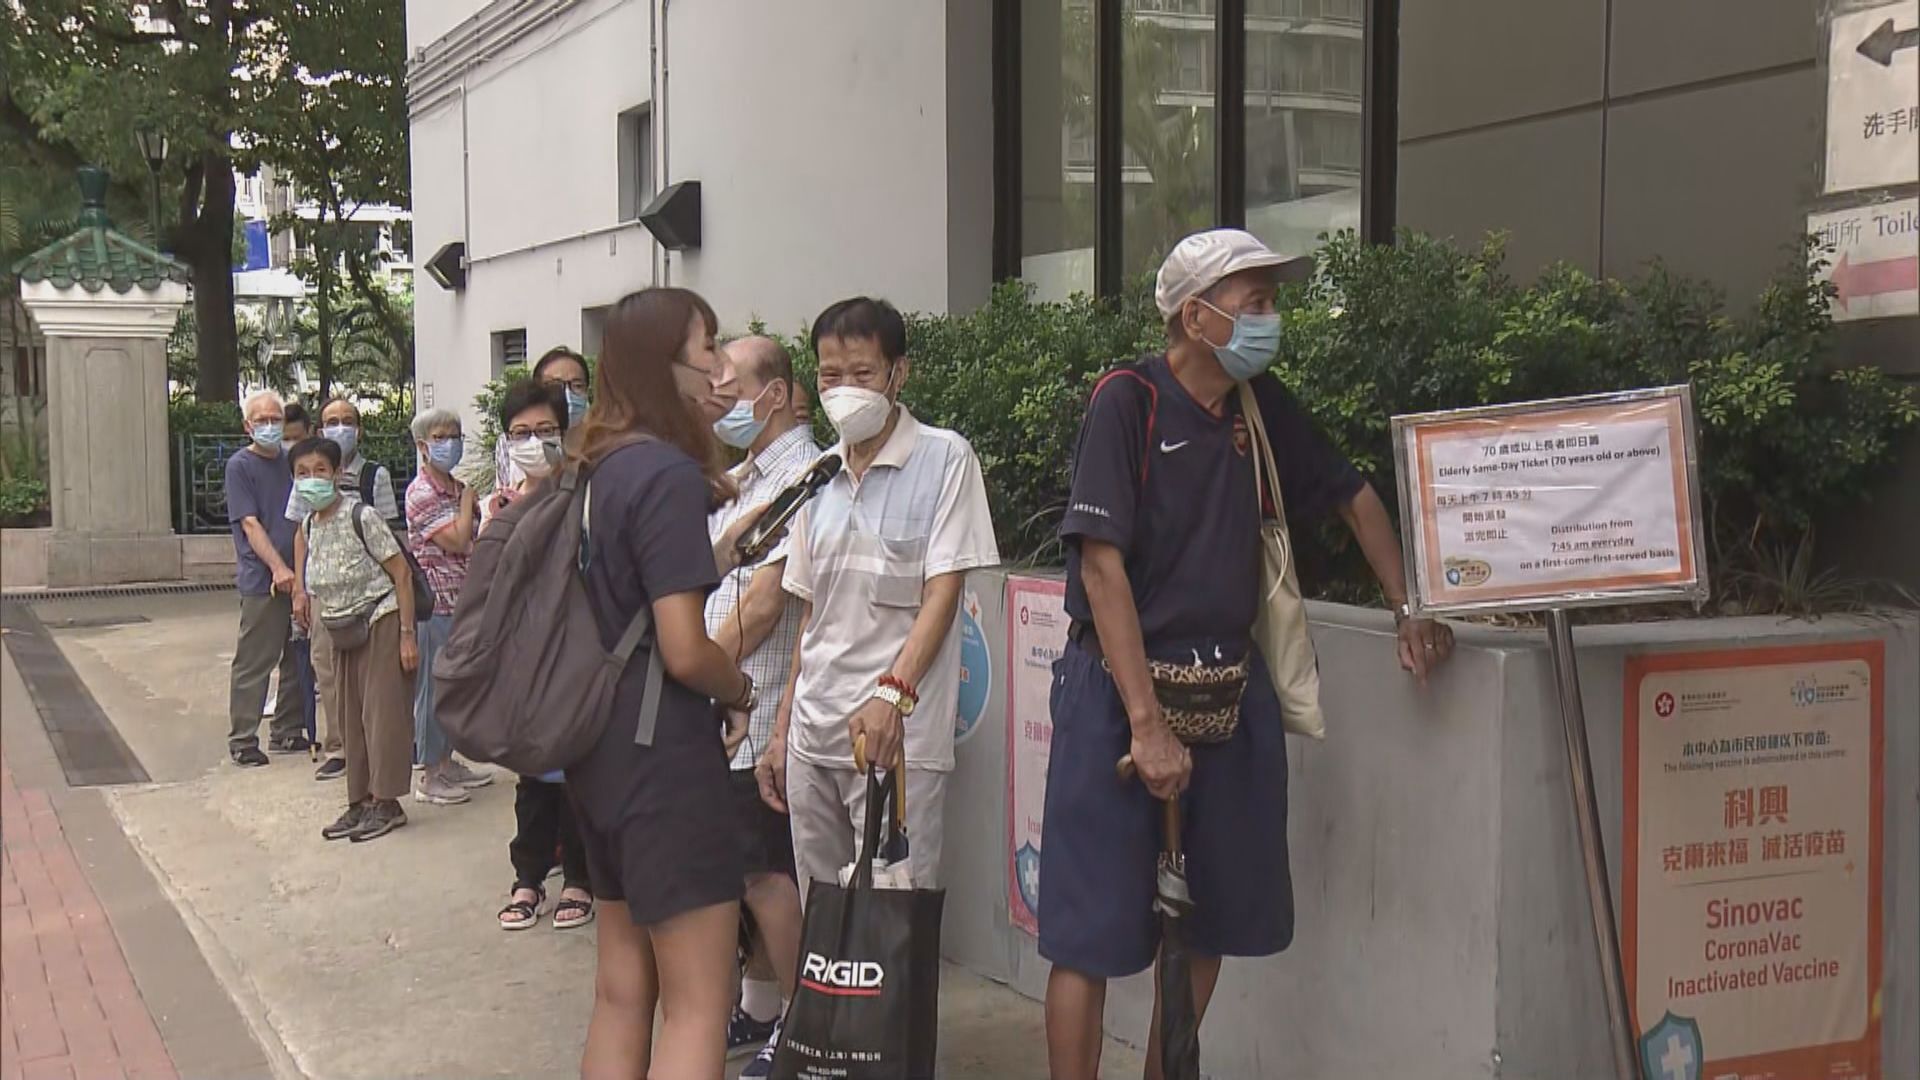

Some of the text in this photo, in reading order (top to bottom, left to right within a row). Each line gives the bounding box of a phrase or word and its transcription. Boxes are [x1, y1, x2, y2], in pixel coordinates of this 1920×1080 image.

[1439, 445, 1661, 478] Elderly Same-Day Ticket (70 years old or above)
[1072, 502, 1110, 517] ARSENAL
[1551, 518, 1633, 535] Distribution from
[1519, 548, 1675, 570] on a first-come-first-served basis
[1551, 536, 1634, 553] 7:45 am everyday
[1664, 763, 1677, 773] The
[1724, 785, 1788, 829] 科興
[1662, 837, 1749, 872] 克爾來福
[1706, 896, 1803, 929] Sinovac
[1704, 931, 1801, 961] CoronaVac
[1668, 957, 1840, 999] Inactivated Vaccine
